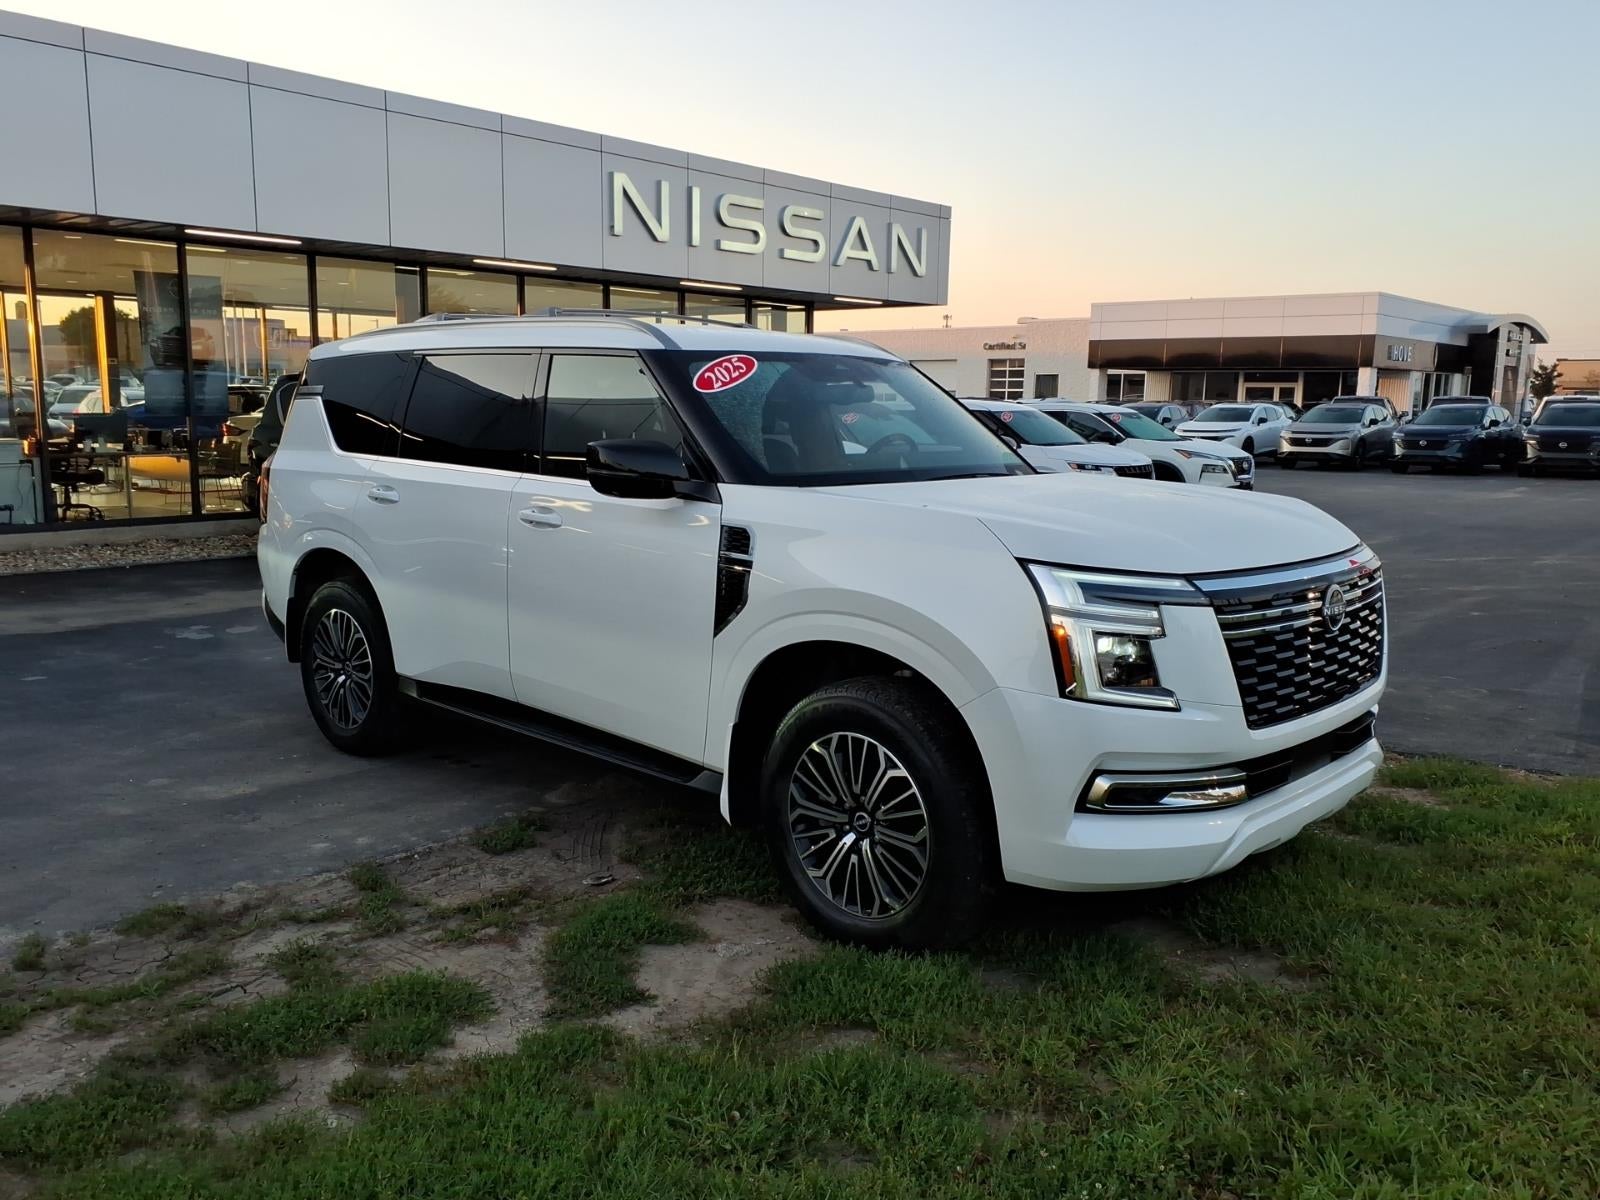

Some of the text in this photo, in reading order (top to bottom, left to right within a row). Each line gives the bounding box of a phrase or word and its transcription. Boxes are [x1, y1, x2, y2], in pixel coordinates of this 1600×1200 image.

[608, 171, 927, 277] NISSAN
[983, 342, 1015, 350] Certified
[704, 357, 746, 389] 2025
